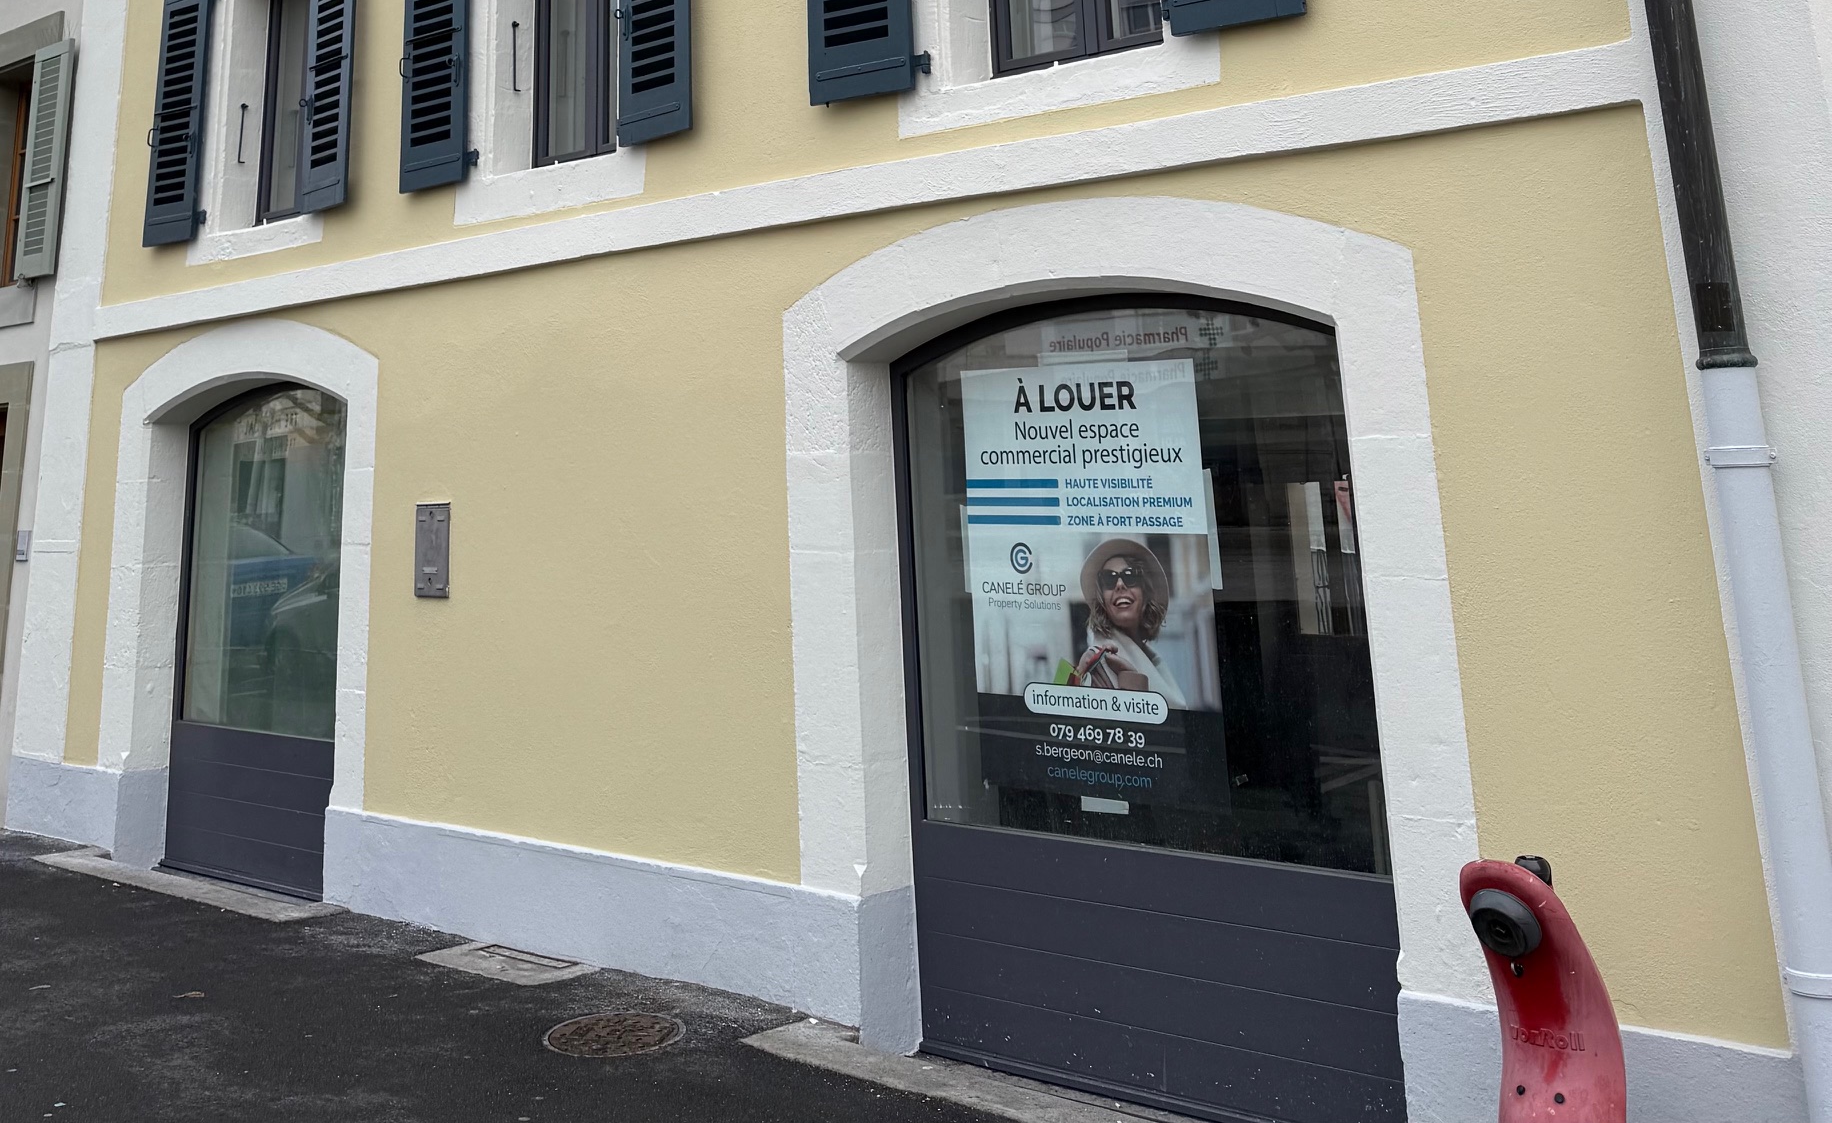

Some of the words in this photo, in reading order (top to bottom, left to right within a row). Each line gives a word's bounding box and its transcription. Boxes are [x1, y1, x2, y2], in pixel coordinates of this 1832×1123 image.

[1014, 378, 1032, 413] À
[1039, 381, 1137, 412] LOUER
[1014, 419, 1073, 440] Nouvel
[1078, 422, 1140, 444] espace
[980, 443, 1077, 465] commercial
[1082, 443, 1183, 469] prestigieux
[1065, 478, 1099, 489] HAUTE
[1100, 475, 1153, 489] VISIBILITÉ
[1066, 496, 1140, 507] LOCALISATION
[1142, 496, 1193, 508] PREMIUM
[1067, 516, 1095, 526] ZONE
[1097, 513, 1104, 526] À
[1106, 516, 1133, 527] FORT
[1135, 516, 1183, 527] PASSAGE
[982, 580, 1024, 595] CANELÉ
[1026, 583, 1066, 596] GROUP
[988, 597, 1022, 610] Property
[1024, 598, 1061, 610] Solutions
[1032, 690, 1108, 711] information
[1111, 696, 1121, 712] &
[1124, 698, 1159, 716] visite
[1050, 724, 1074, 741] 079
[1077, 725, 1103, 744] 469
[1106, 728, 1124, 745] 78
[1127, 731, 1146, 748] 39
[1035, 742, 1163, 768] s.bergeon@canele.ch
[1047, 765, 1152, 788] canelegroup.com
